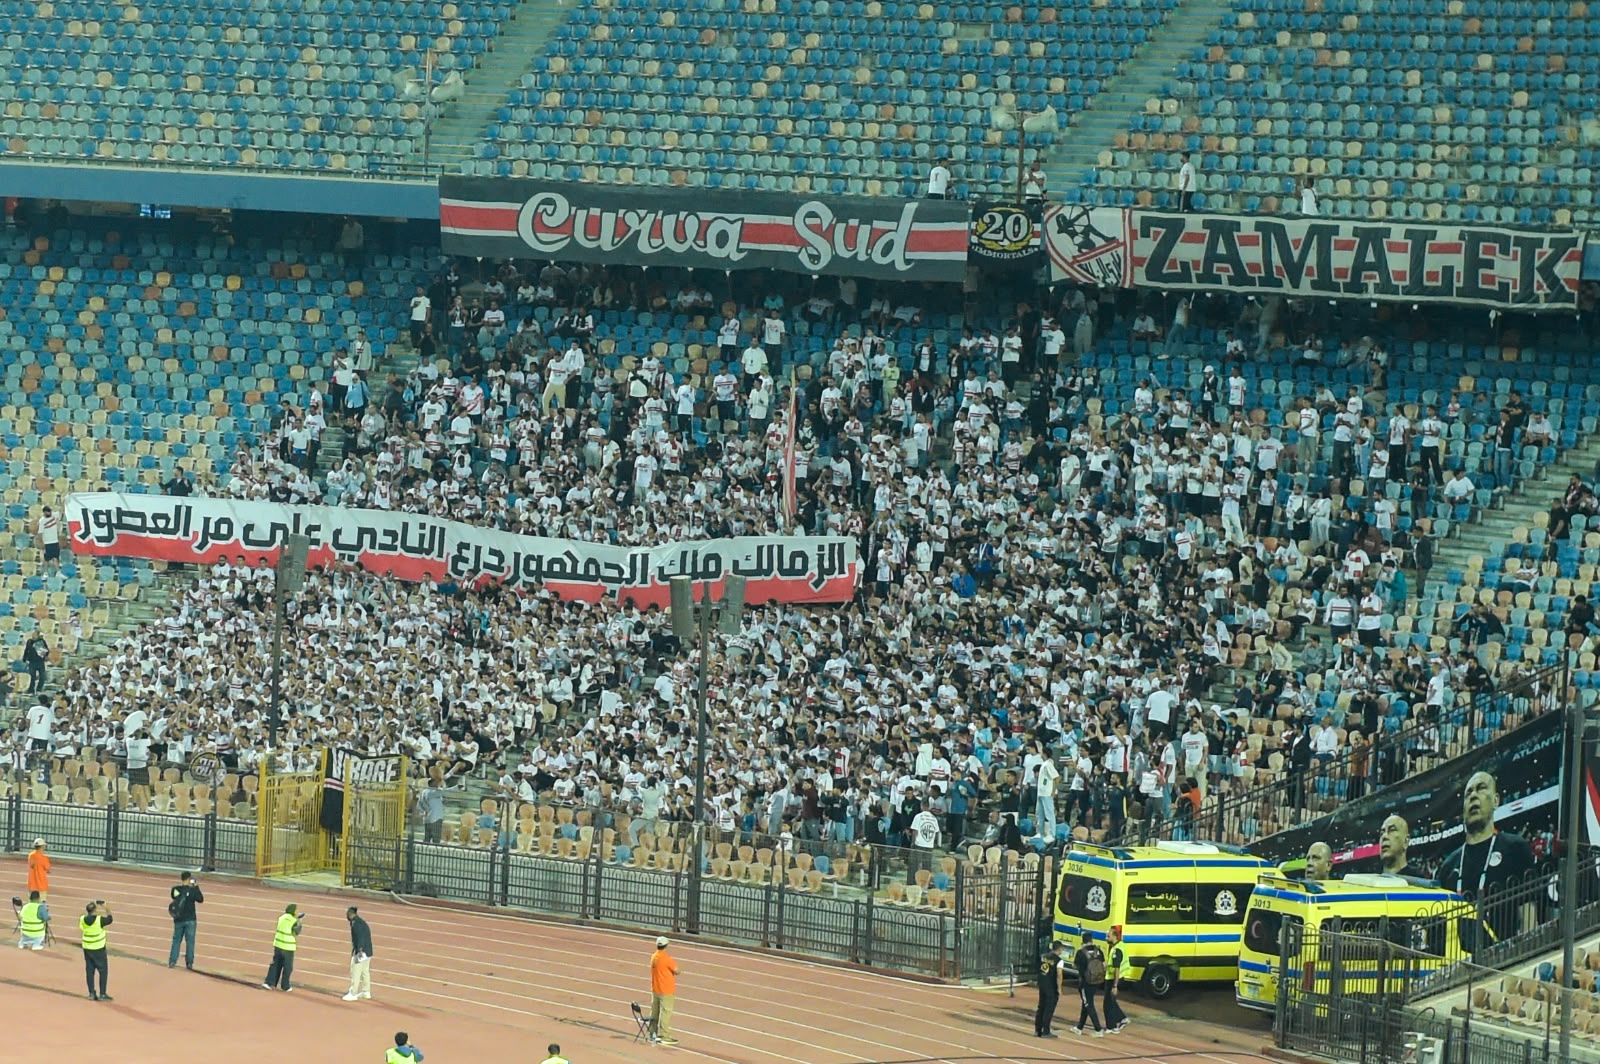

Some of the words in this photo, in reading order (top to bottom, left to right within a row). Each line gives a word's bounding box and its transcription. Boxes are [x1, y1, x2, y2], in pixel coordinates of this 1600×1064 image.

[516, 191, 749, 261] Curva
[793, 200, 919, 272] Sud
[982, 212, 1029, 241] 20
[974, 246, 1035, 260] IMMORTALS
[1139, 215, 1580, 306] ZAMALEK
[77, 504, 193, 544] العصور
[195, 514, 234, 552] مر
[332, 521, 447, 562] النادي
[504, 550, 649, 598] الجمهور
[657, 549, 721, 583] ملك
[732, 542, 847, 589] الزمالك
[37, 714, 44, 725] 1
[331, 751, 399, 785] VRAGE
[1429, 832, 1443, 842] CUP
[1067, 863, 1084, 873] 3036
[1165, 892, 1179, 901] وزارة
[1253, 898, 1271, 909] 3013
